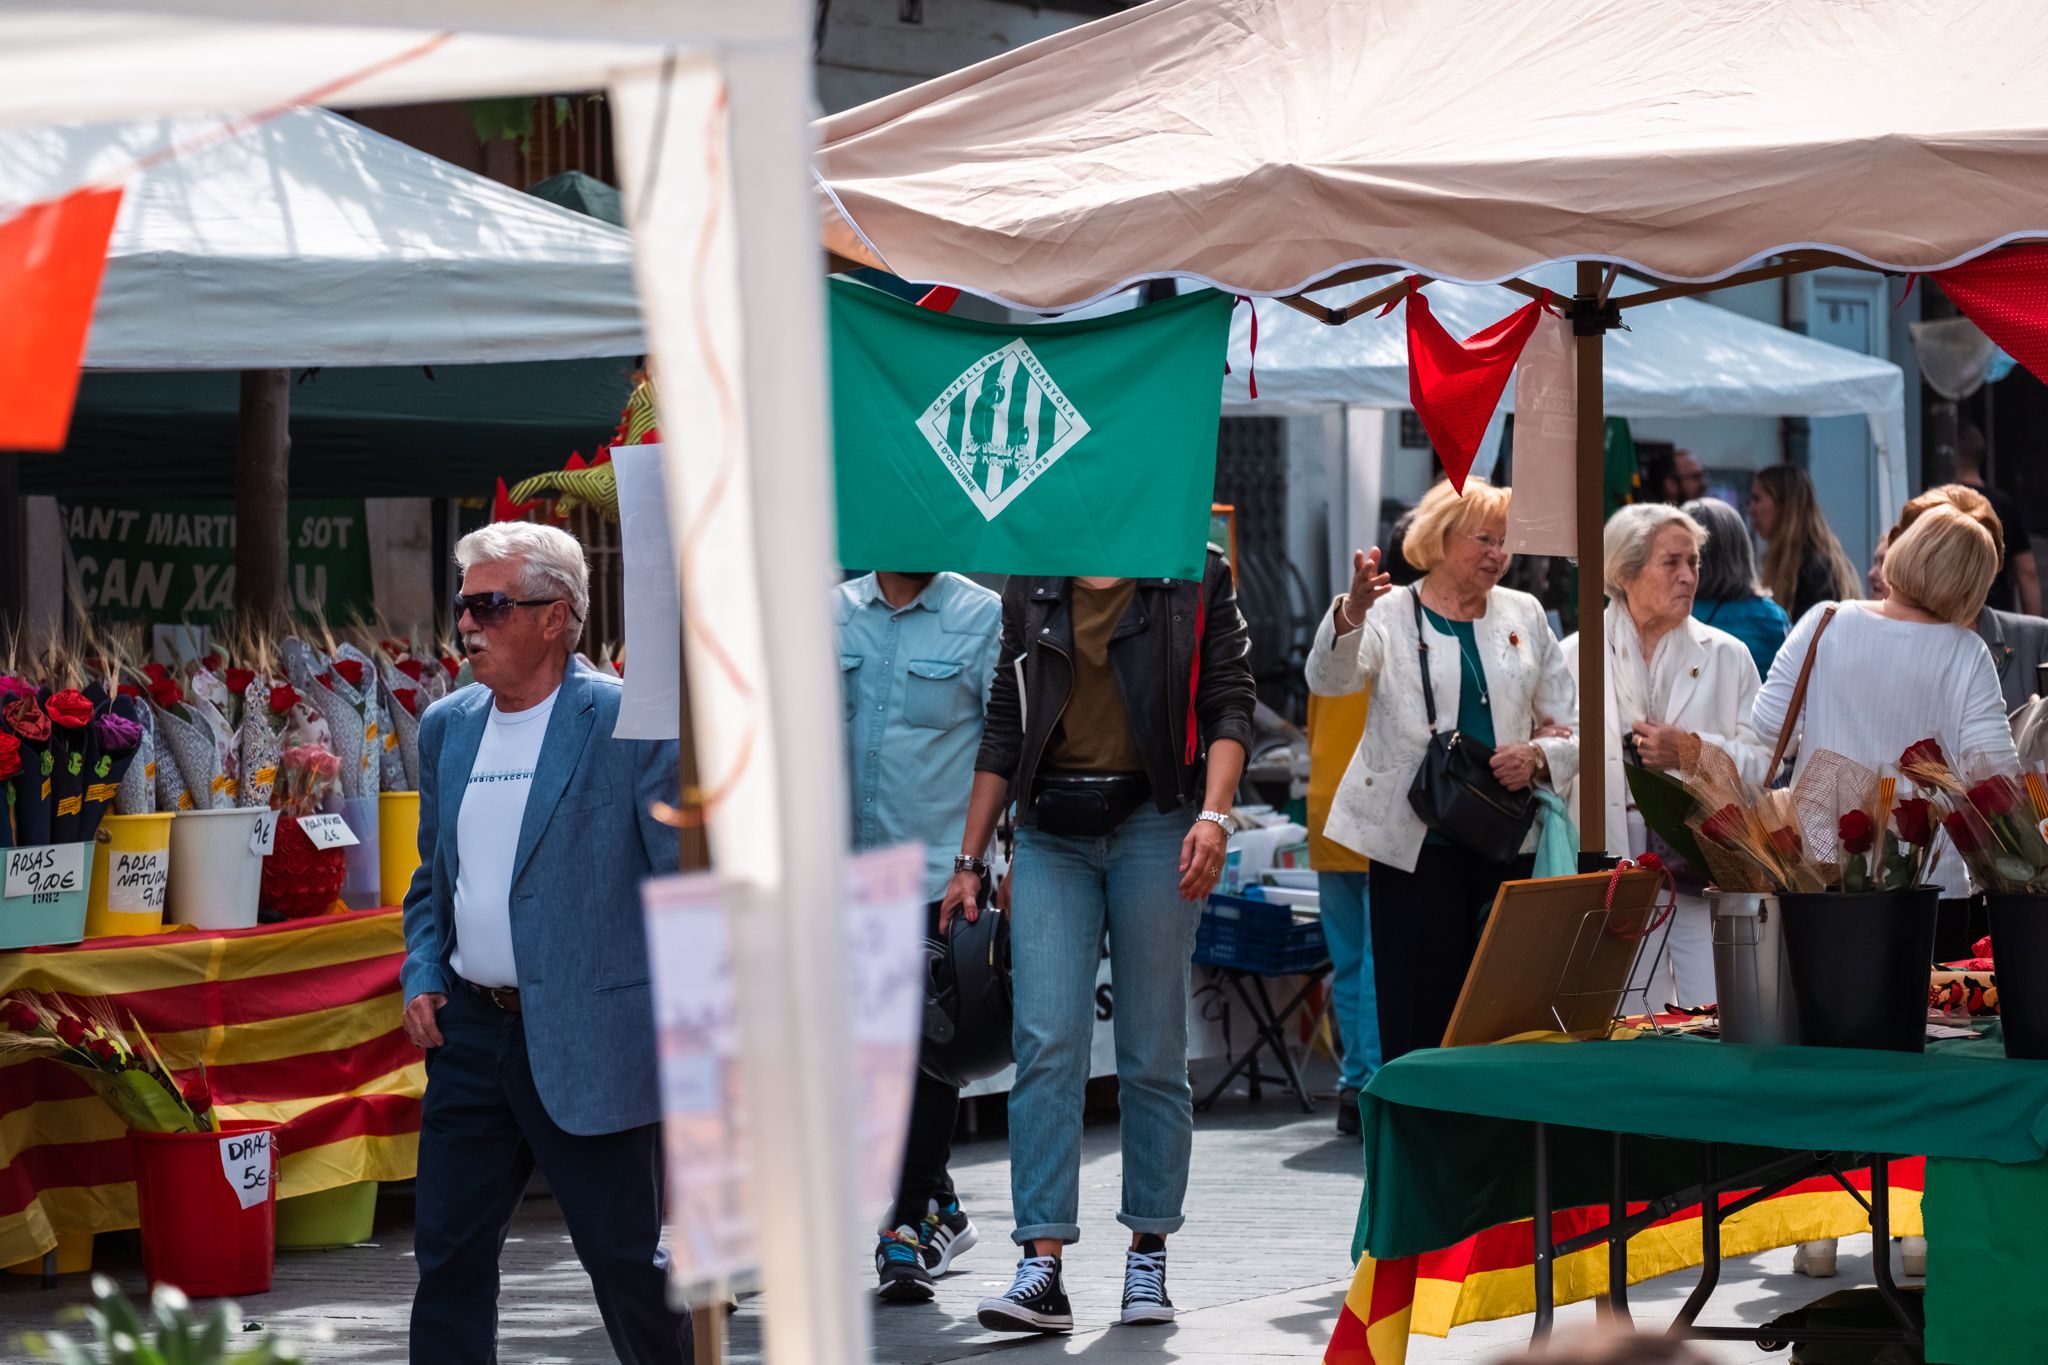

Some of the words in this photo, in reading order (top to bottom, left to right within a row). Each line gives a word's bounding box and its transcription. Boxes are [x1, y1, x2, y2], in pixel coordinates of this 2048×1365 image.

[933, 351, 1005, 412] CASTELLERS
[1021, 350, 1075, 419] CERDANYOLA
[941, 447, 976, 492] D'OCTUBRE
[1023, 457, 1049, 482] 1998
[298, 517, 354, 549] SOT
[77, 556, 174, 609] CAN
[183, 564, 327, 612] XAU
[10, 849, 56, 876] ROSAS
[117, 854, 157, 873] ROSA
[28, 871, 75, 892] 9,00€
[228, 1133, 267, 1161] DRAC
[243, 1166, 267, 1189] 5€
